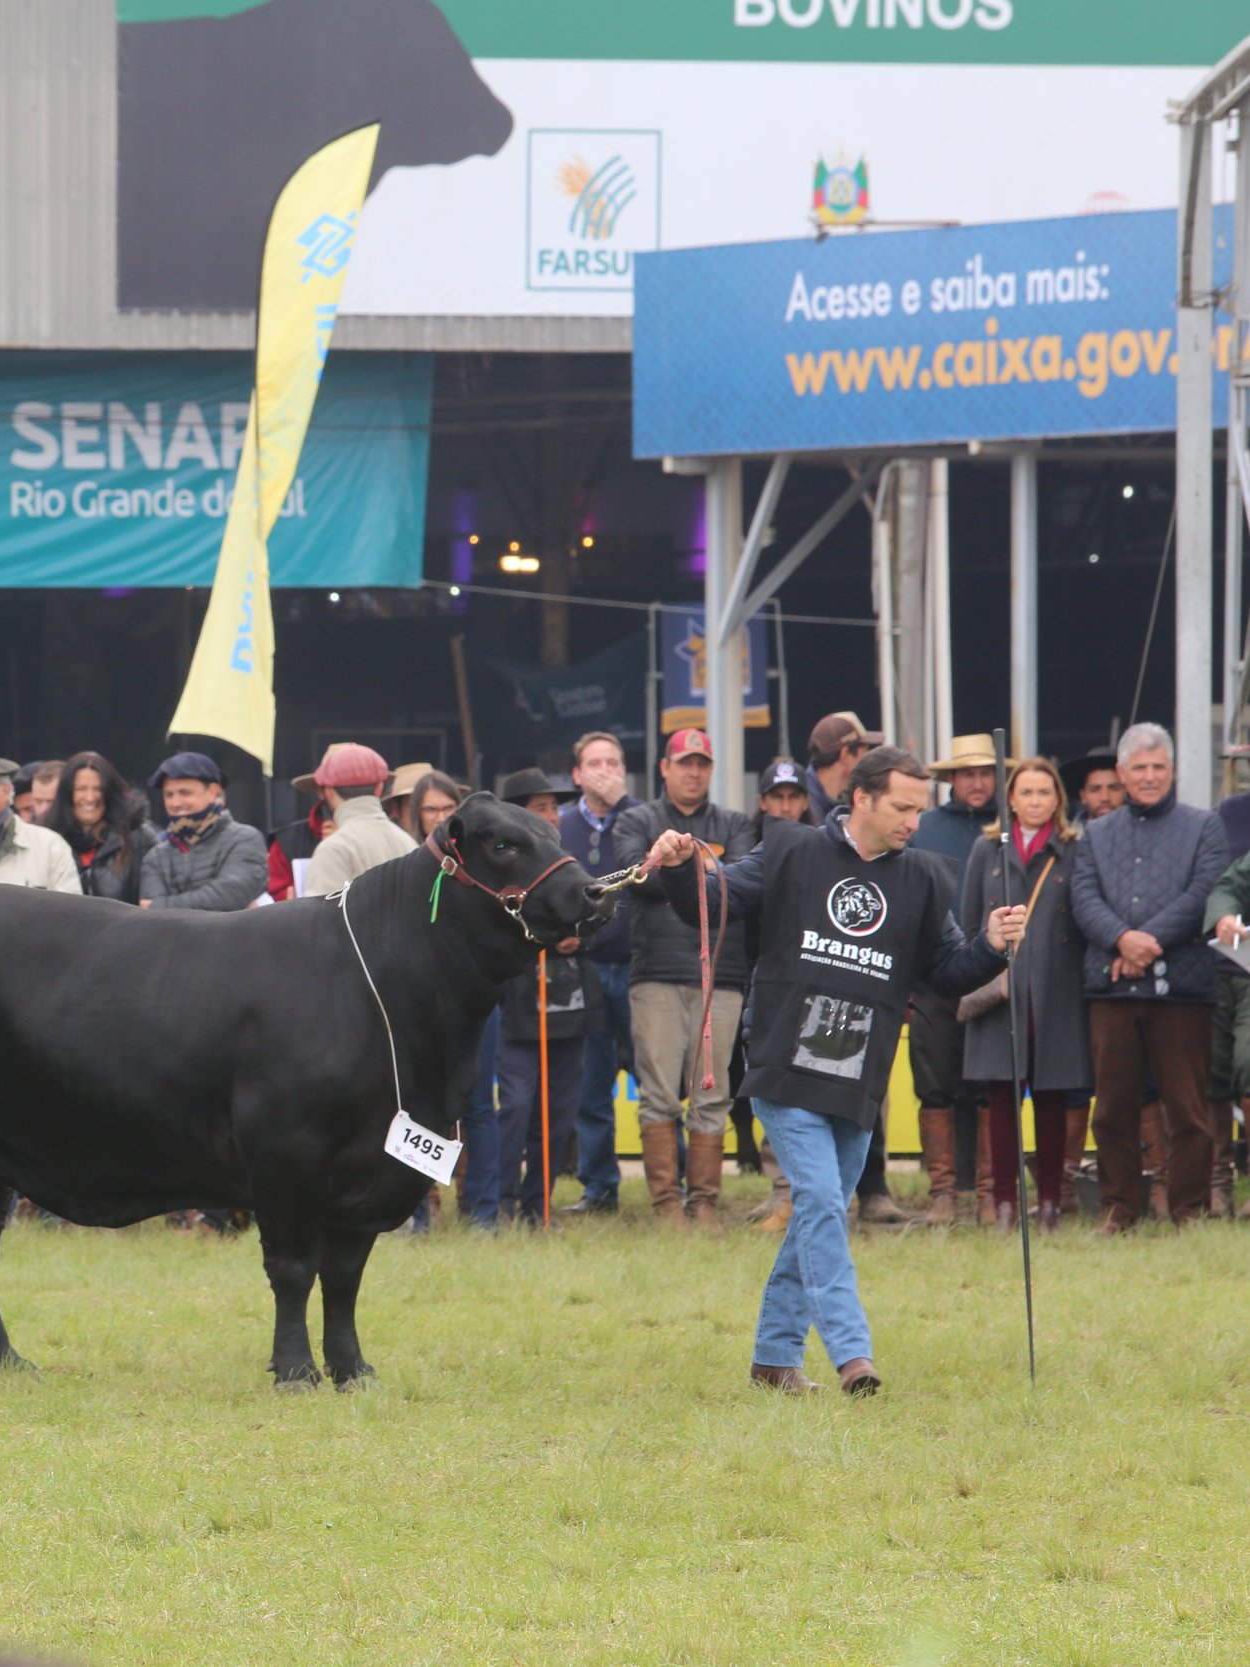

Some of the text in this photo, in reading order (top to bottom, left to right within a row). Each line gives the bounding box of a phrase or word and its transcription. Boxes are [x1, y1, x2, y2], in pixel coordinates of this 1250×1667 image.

[537, 248, 632, 276] FARSU
[785, 250, 1110, 322] Acesse e saiba mais:
[10, 480, 66, 517] Rio
[72, 478, 195, 518] Grande
[801, 930, 893, 970] Brangus
[402, 1127, 445, 1161] 1495
